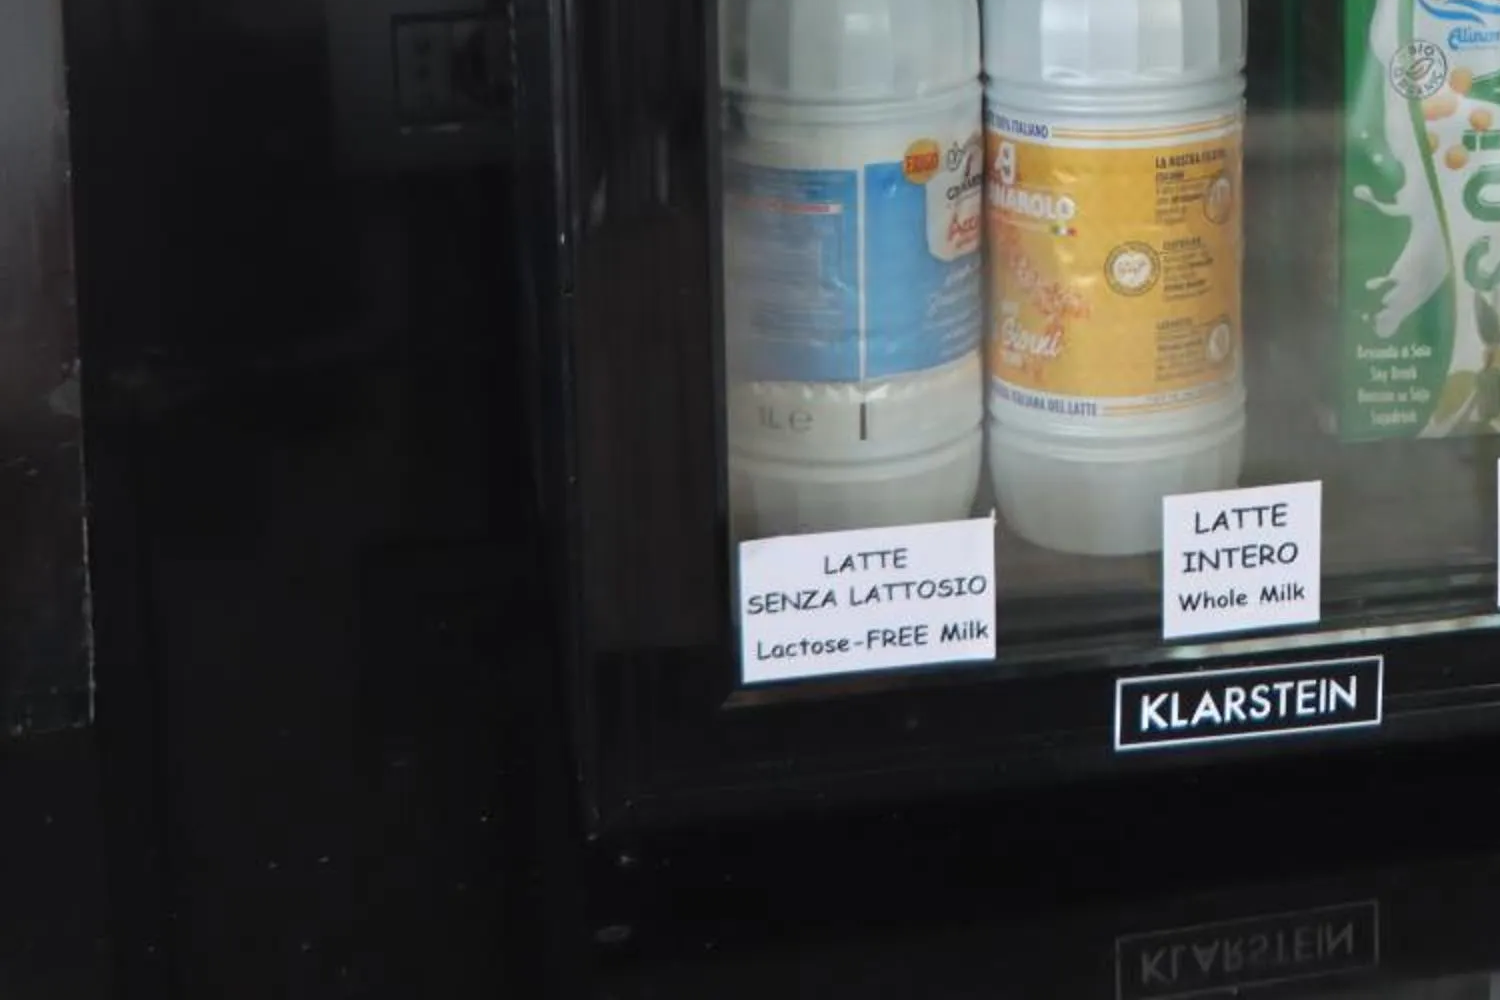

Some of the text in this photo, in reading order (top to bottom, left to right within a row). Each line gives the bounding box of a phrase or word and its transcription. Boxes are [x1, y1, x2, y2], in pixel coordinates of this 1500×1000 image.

[1068, 400, 1097, 416] LATTE
[1195, 502, 1288, 535] LATTE
[824, 548, 908, 575] LATTE
[1182, 541, 1299, 574] INTERO
[747, 575, 987, 615] SENZA LATTOSIO
[1178, 582, 1306, 612] Whole Milk
[757, 620, 990, 661] Lactose-FREE Milk
[1140, 674, 1358, 732] KLARSTEIN
